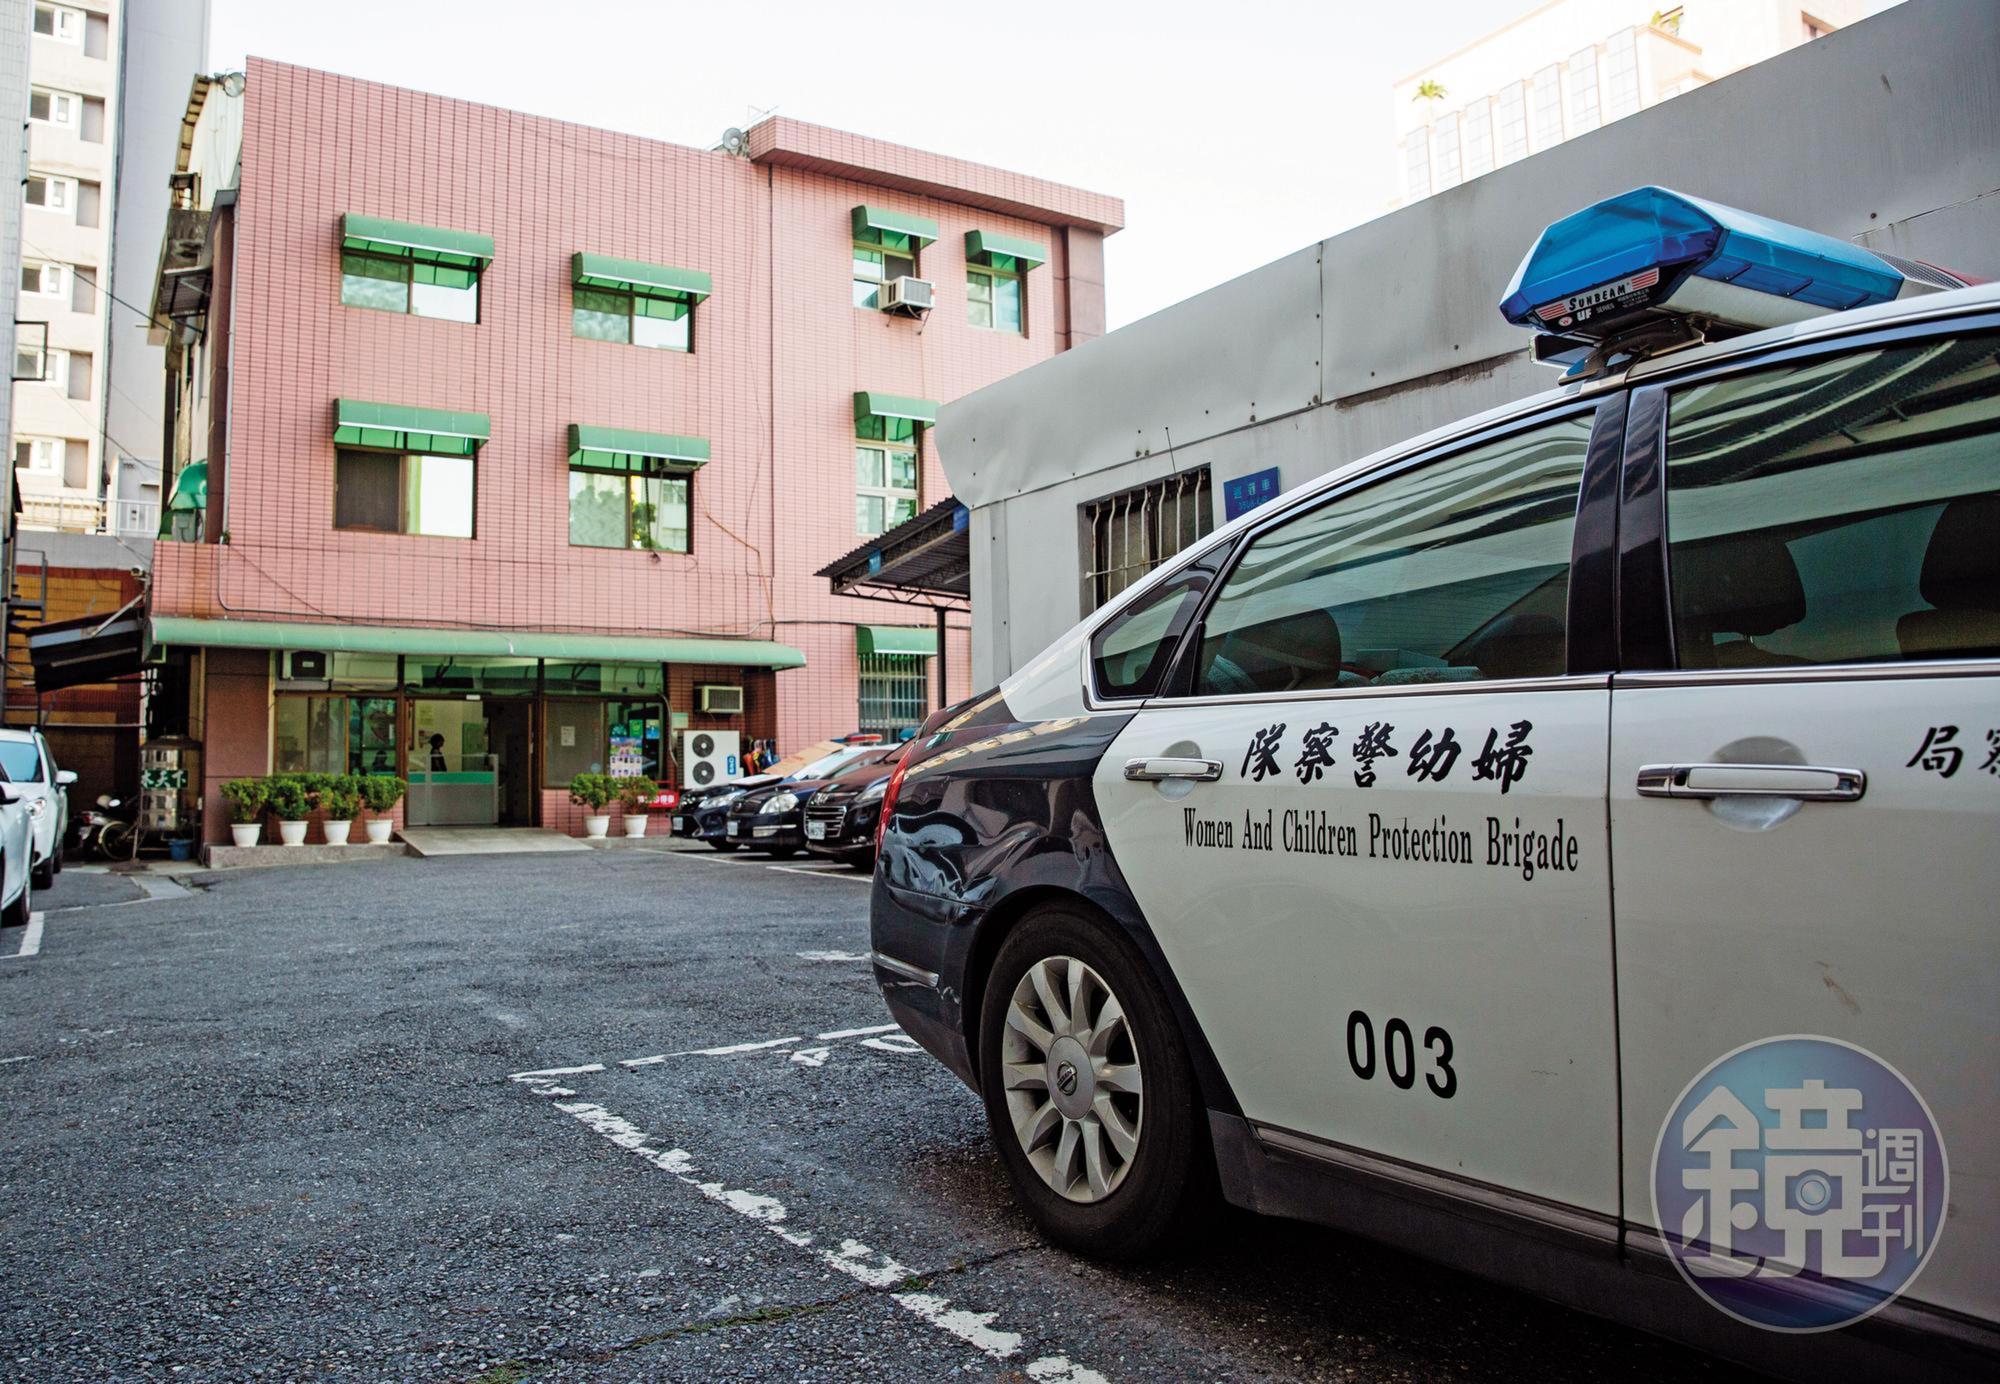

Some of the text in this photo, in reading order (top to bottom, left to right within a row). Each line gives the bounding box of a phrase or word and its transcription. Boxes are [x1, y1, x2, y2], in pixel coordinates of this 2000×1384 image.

[1569, 284, 1626, 311] SUNBEAM
[1184, 807, 1579, 882] Women And Children Protection Brigade
[1347, 1010, 1458, 1099] 003
